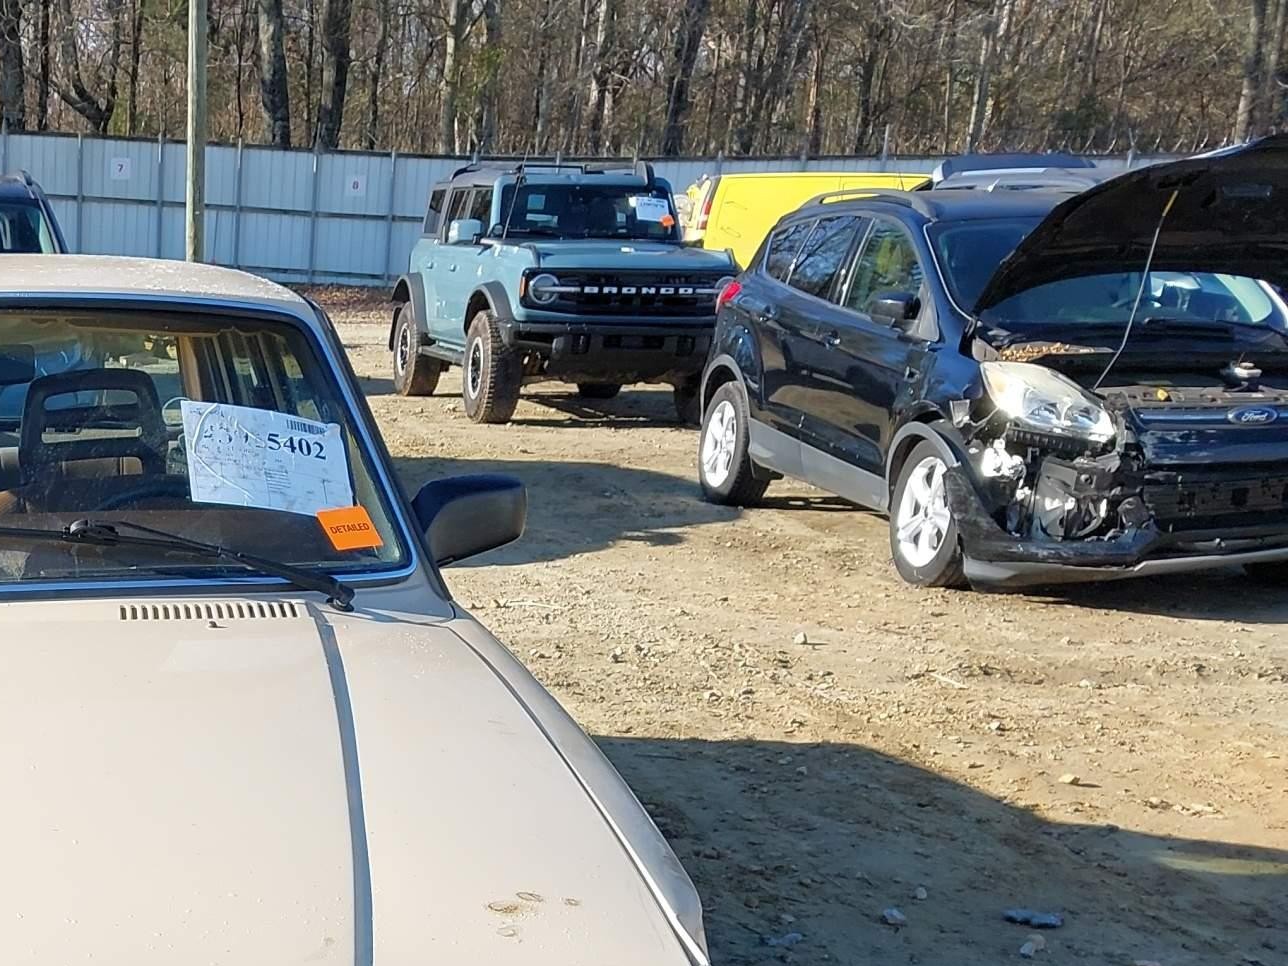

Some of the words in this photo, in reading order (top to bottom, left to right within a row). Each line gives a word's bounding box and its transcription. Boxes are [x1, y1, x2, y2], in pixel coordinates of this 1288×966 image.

[583, 286, 694, 295] BRONCO
[1241, 410, 1269, 422] Ford
[329, 522, 370, 534] DETAILED
